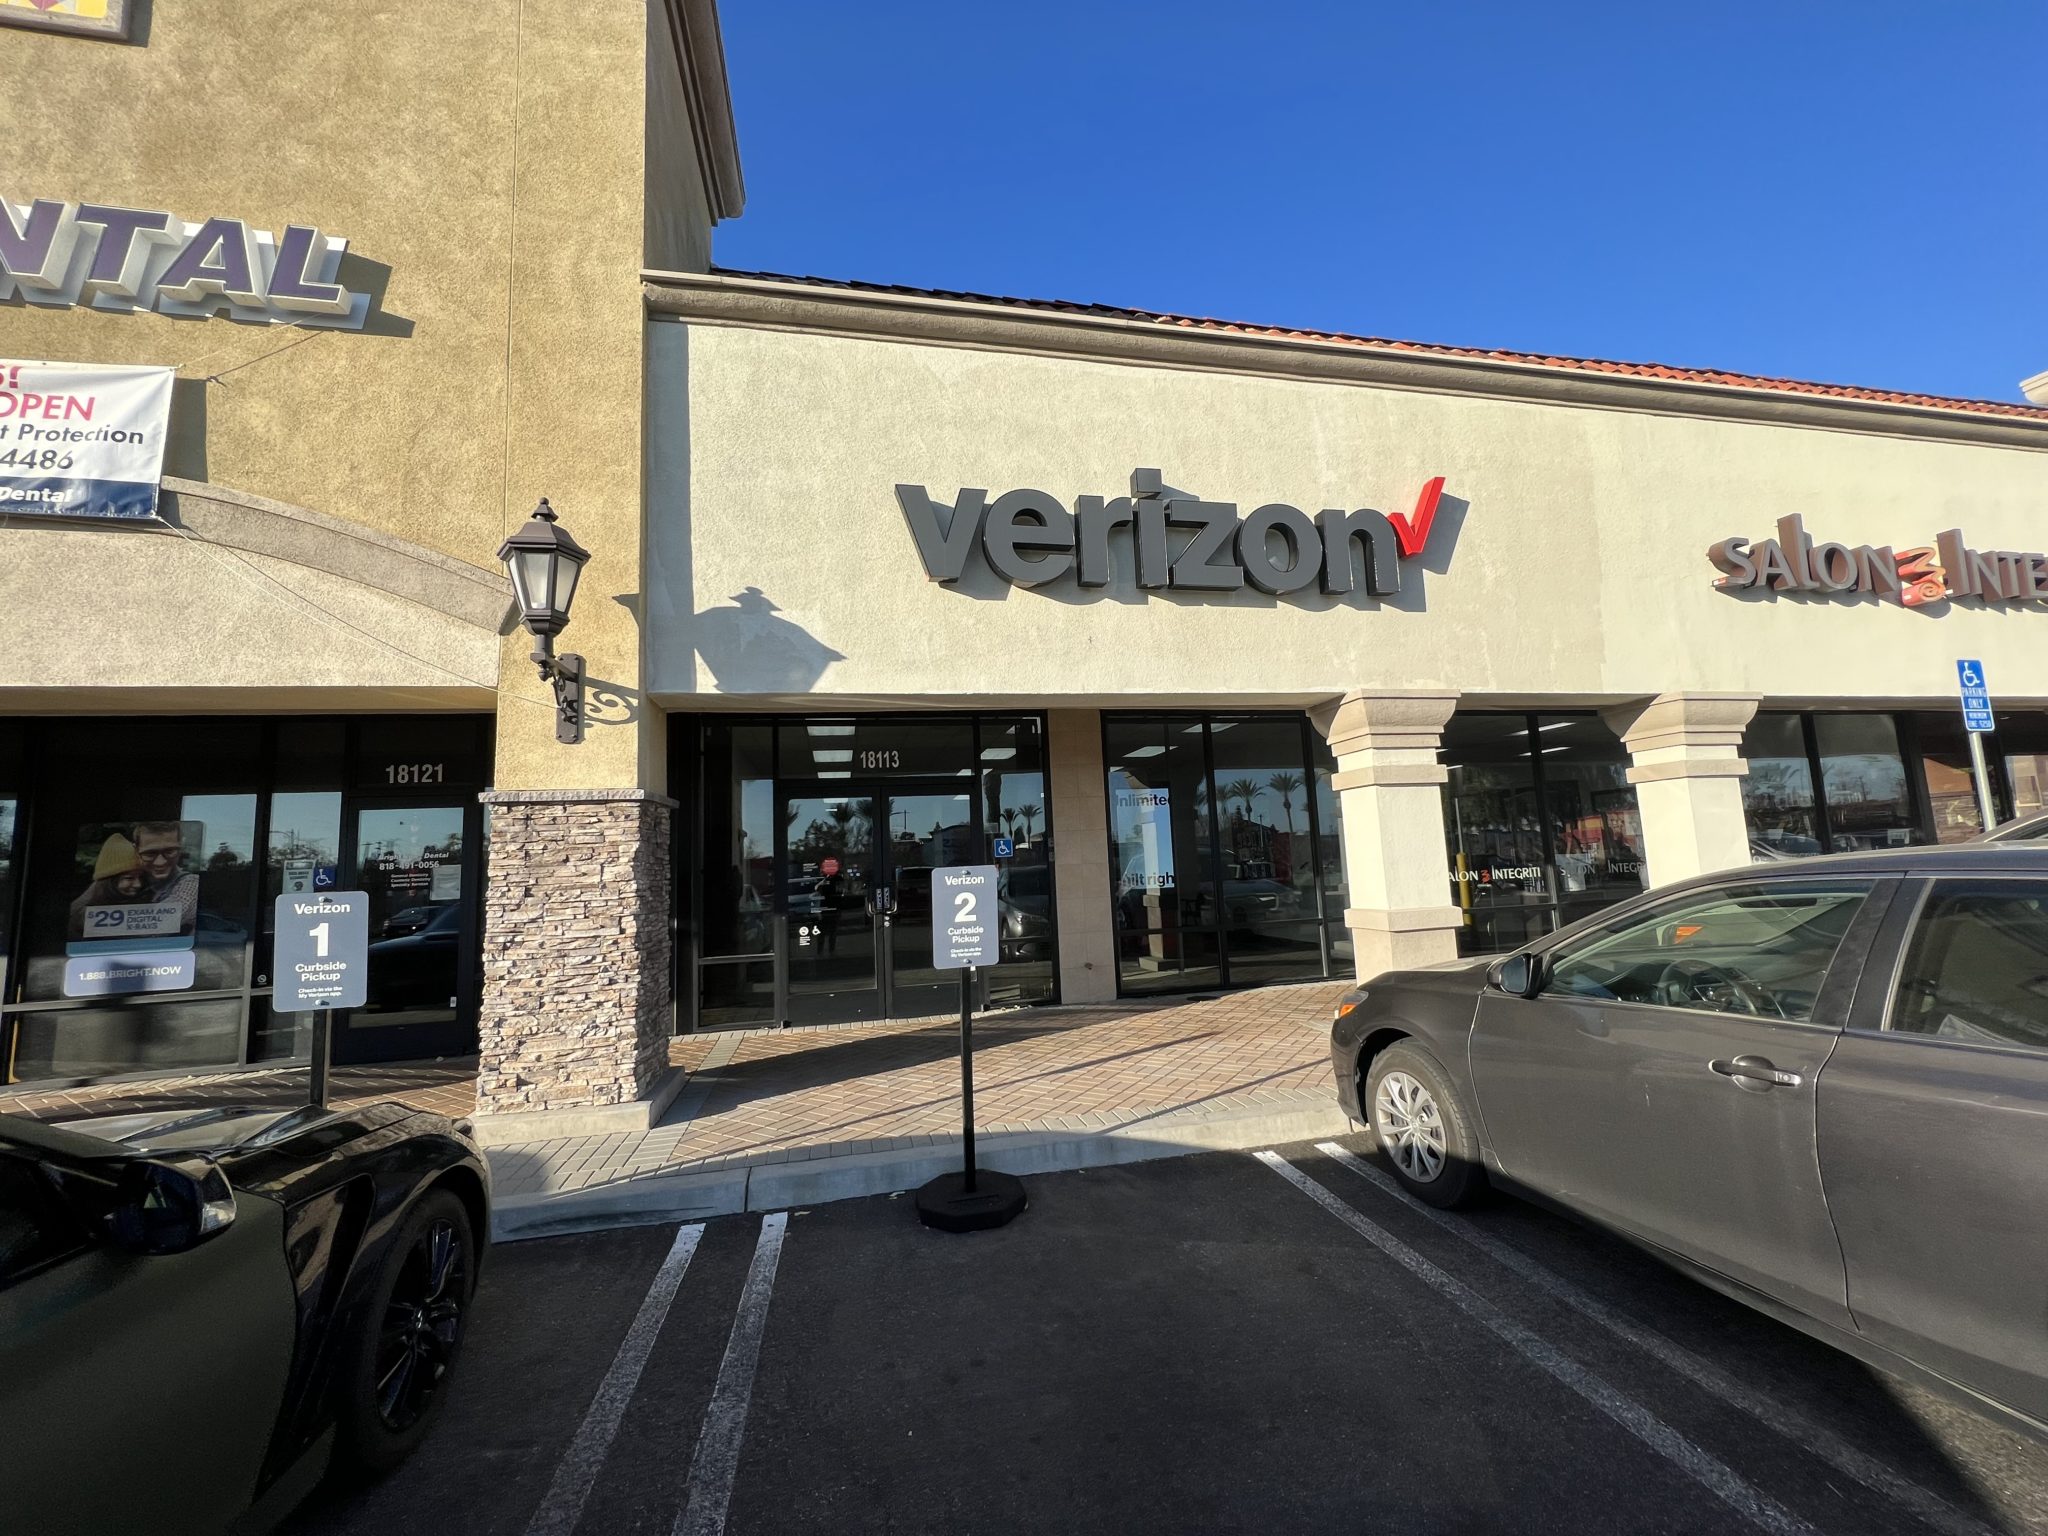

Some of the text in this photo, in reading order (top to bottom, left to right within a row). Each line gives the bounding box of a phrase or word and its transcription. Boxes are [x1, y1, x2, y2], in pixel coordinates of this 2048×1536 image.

[0, 196, 351, 316] NTAL
[0, 391, 95, 421] OPEN
[18, 423, 144, 445] Protection
[0, 448, 74, 470] 4486
[0, 486, 74, 503] Dental
[895, 468, 1401, 597] verizon
[860, 750, 900, 769] 18113
[386, 763, 443, 784] 18121
[1117, 793, 1170, 807] nlimite
[1449, 864, 1541, 882] ALON INTEGRITI
[1608, 859, 1645, 874] INTEGR
[944, 875, 985, 886] Verizon
[1147, 871, 1175, 887] righ
[127, 907, 177, 916] EXAM AND
[294, 902, 350, 915] Verizon
[954, 891, 977, 923] 2
[87, 909, 125, 928] $29
[126, 922, 158, 930] X-RAYS
[127, 915, 162, 923] DIGITAL
[947, 926, 984, 936] Curbside
[309, 922, 329, 957] 1
[952, 935, 980, 944] Pickup
[295, 961, 347, 973] Curbside
[301, 972, 341, 982] Pickup
